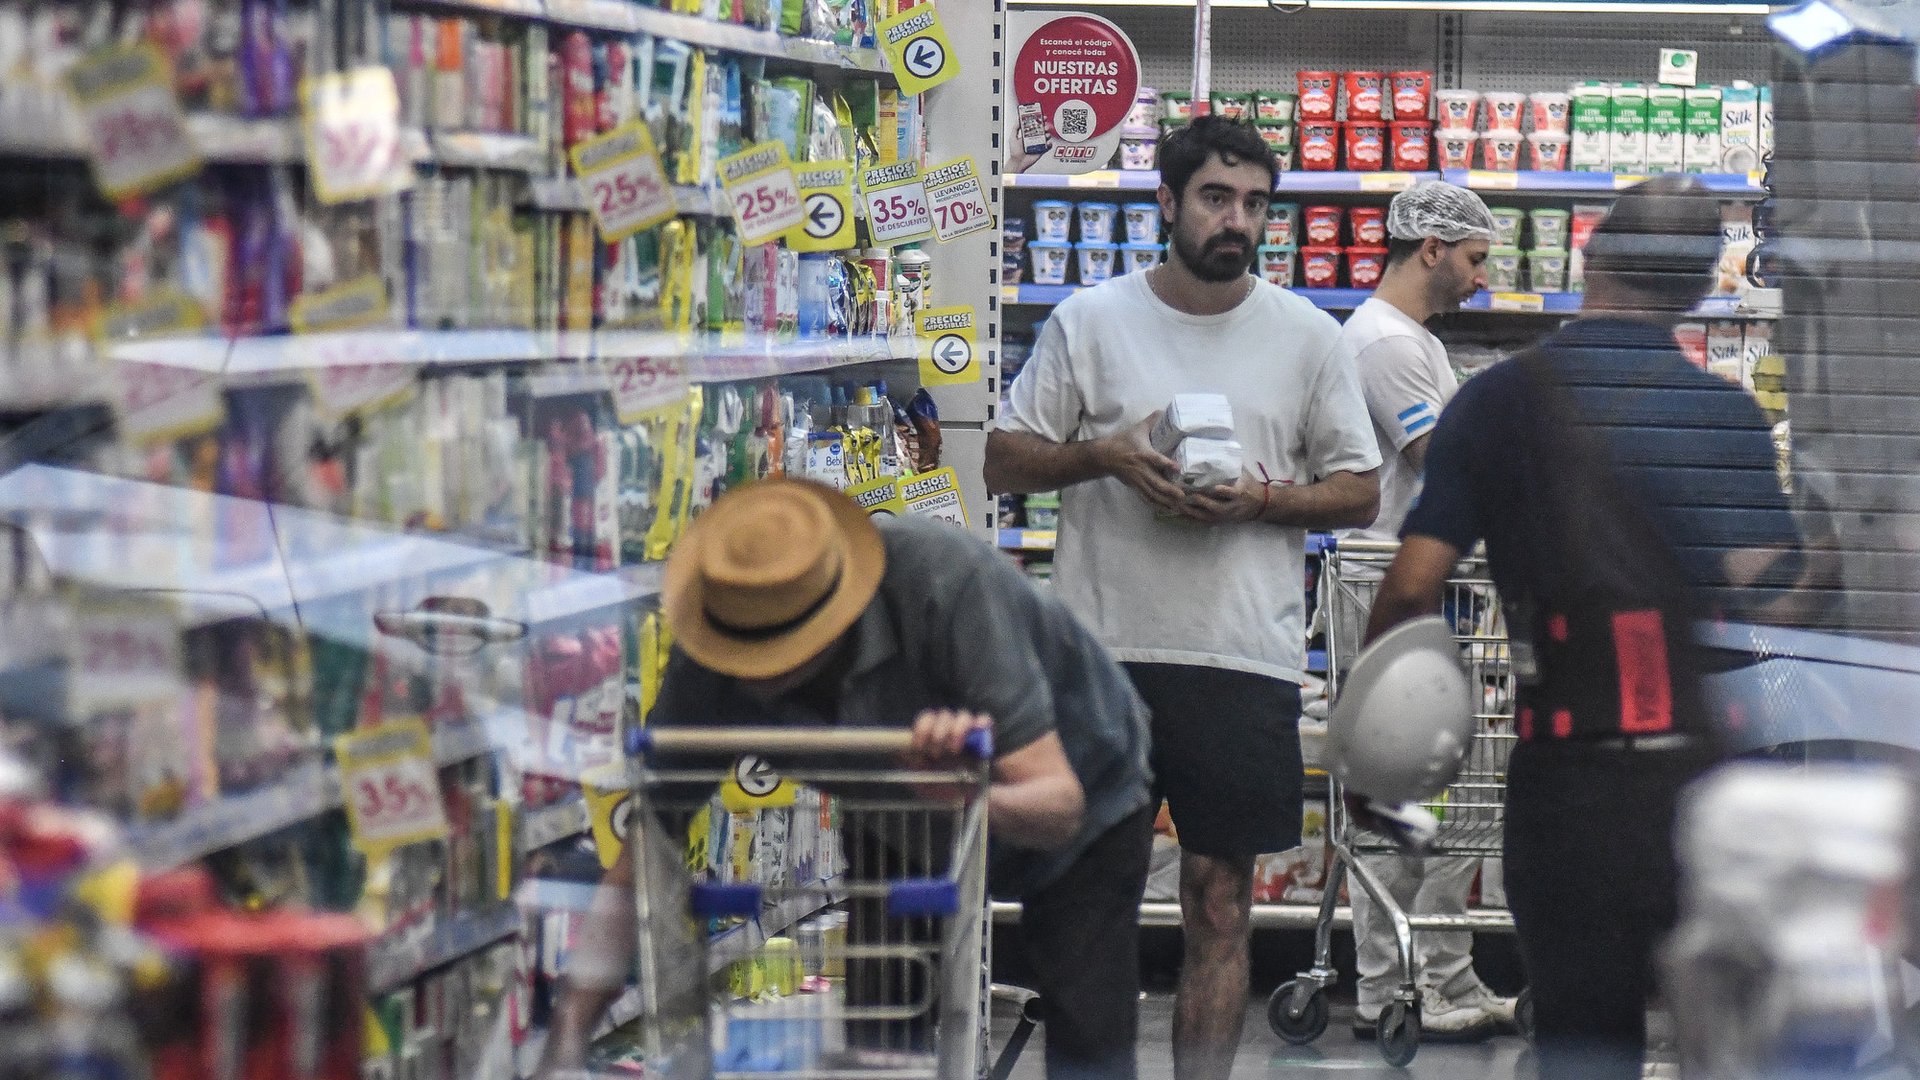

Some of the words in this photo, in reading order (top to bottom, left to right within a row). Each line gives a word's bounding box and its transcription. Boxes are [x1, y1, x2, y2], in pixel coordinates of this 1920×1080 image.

[1040, 38, 1073, 46] Escaneá
[1085, 39, 1112, 48] código
[1034, 60, 1119, 76] NUESTRAS
[1033, 78, 1118, 95] OFERTAS
[1723, 109, 1752, 128] Silk
[1055, 147, 1095, 157] COTO
[934, 182, 970, 198] LLEVANDO
[736, 186, 796, 221] 25%
[873, 195, 926, 223] 35%
[934, 201, 983, 230] 70%
[877, 224, 887, 232] DE
[888, 217, 928, 230] DESCUENTO
[1723, 226, 1750, 244] Silk
[1709, 344, 1738, 361] Silk
[913, 496, 949, 511] LLEVANDO
